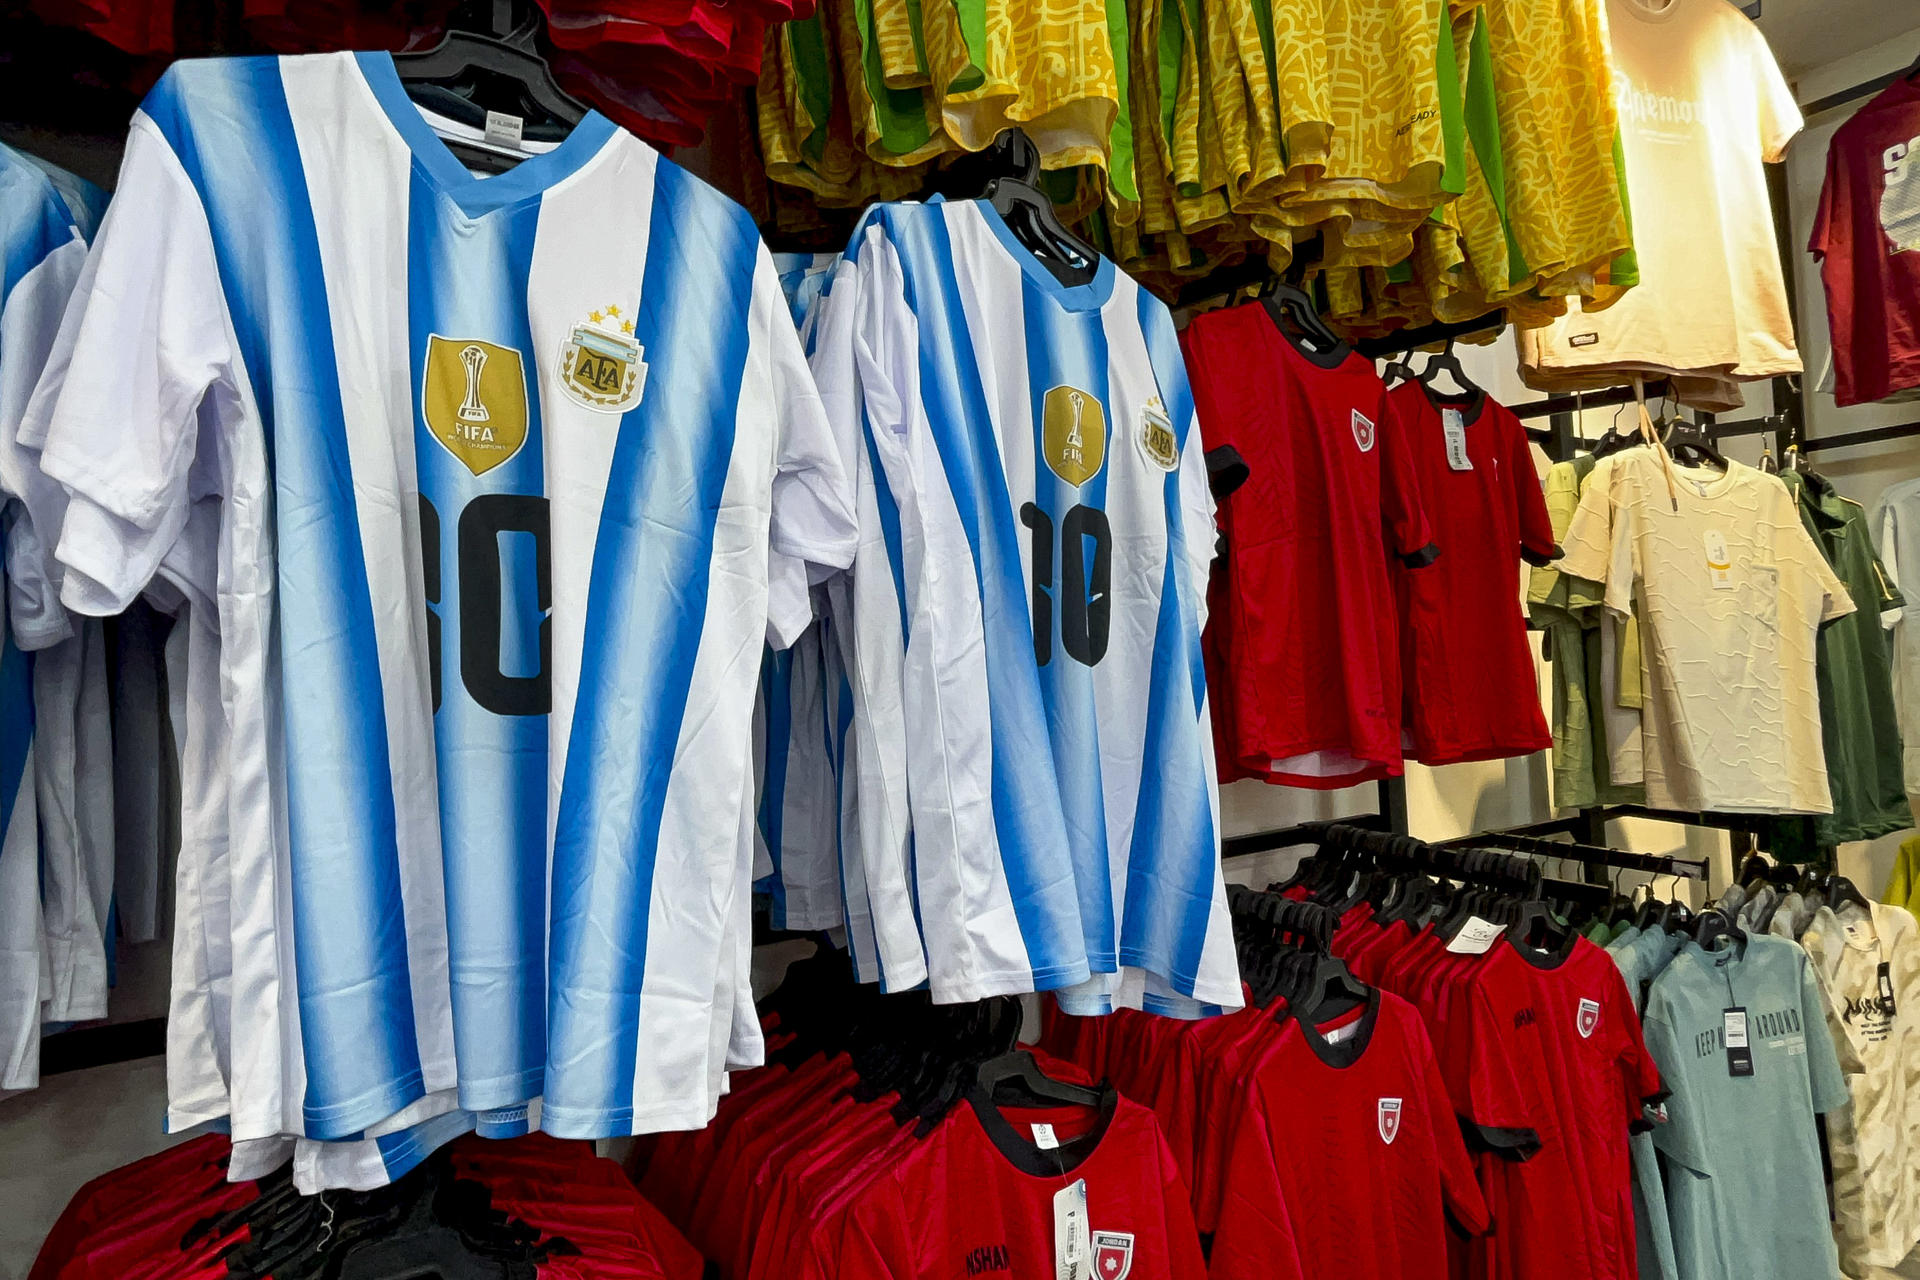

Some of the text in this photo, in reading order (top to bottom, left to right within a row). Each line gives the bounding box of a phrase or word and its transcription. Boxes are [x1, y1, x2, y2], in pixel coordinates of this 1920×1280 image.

[577, 346, 619, 391] AFA
[455, 422, 494, 442] FIFA
[1020, 502, 1112, 667] 10
[1755, 1008, 1800, 1040] AROUND
